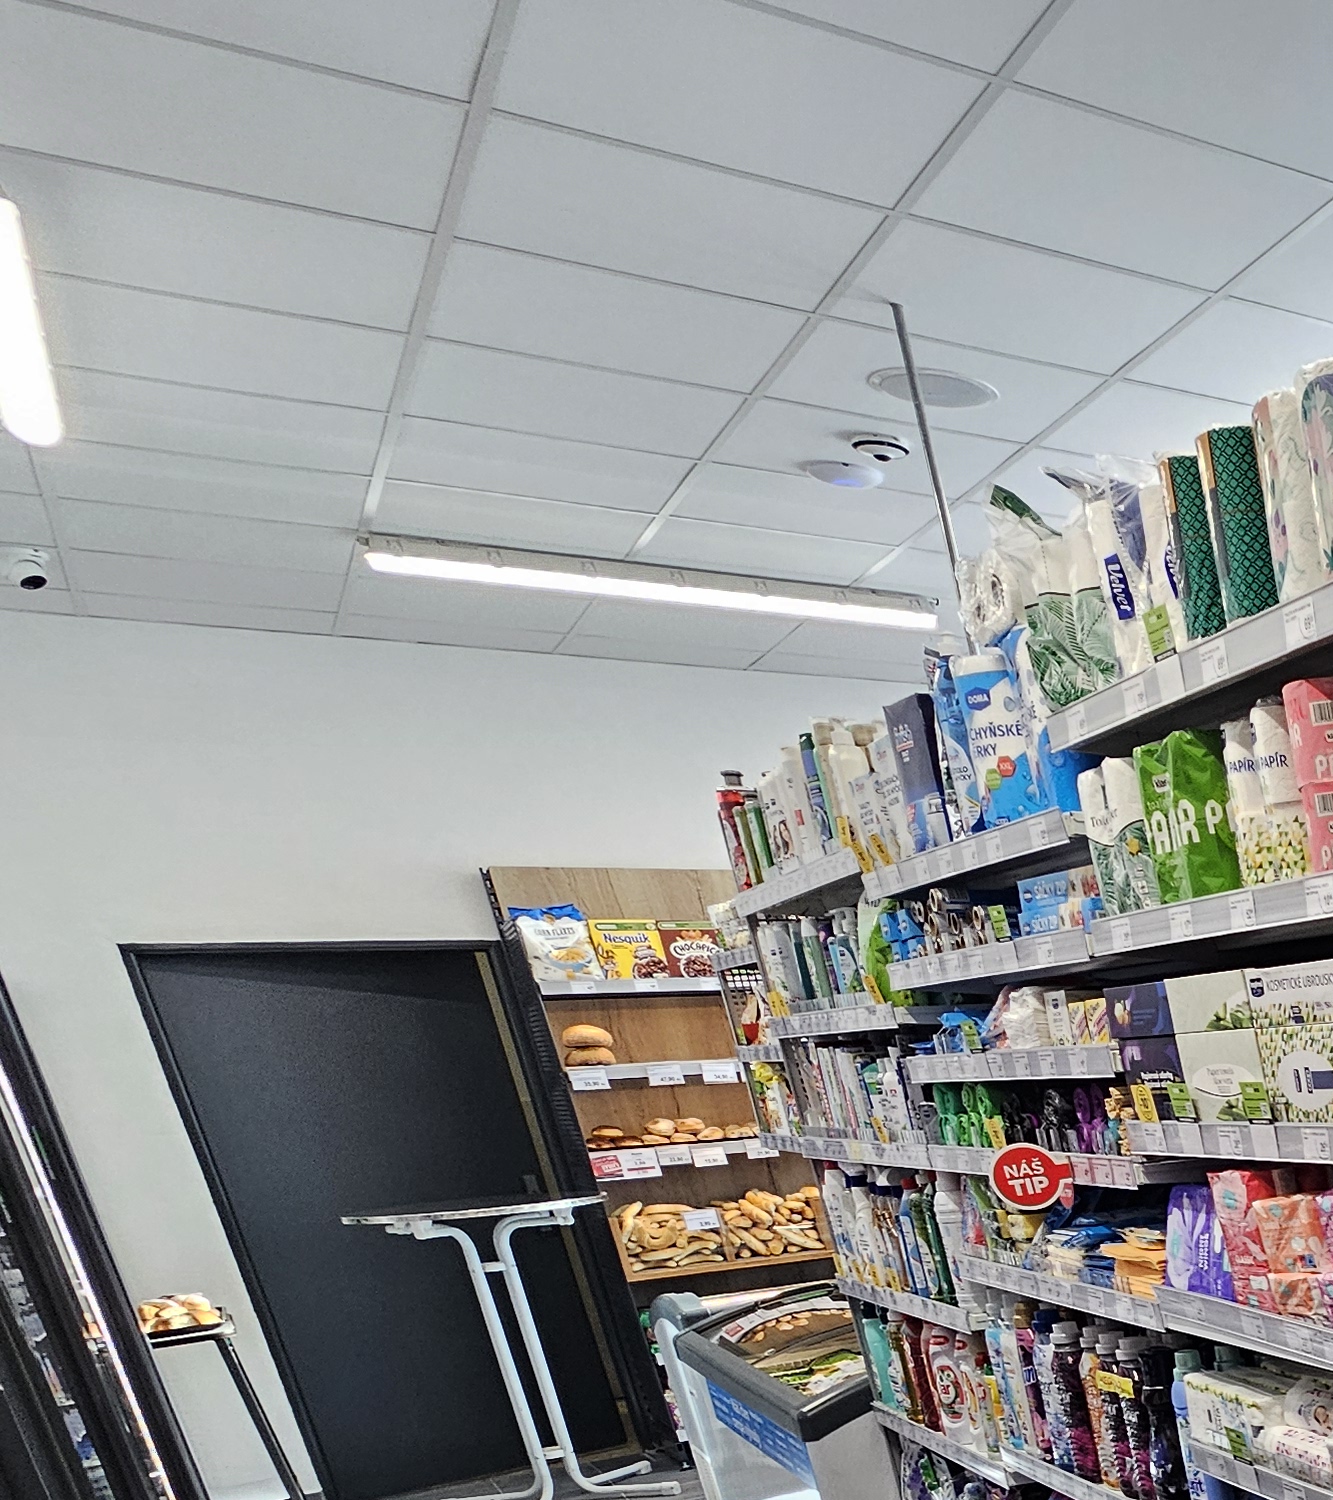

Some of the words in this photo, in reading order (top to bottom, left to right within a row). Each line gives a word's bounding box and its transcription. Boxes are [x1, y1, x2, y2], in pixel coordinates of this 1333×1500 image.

[1105, 559, 1131, 614] Velvet
[1228, 753, 1257, 774] PAPÍR
[1259, 750, 1289, 770] PAPÍR
[602, 932, 651, 945] Nesquik
[1003, 1156, 1045, 1180] NÁŠ
[1007, 1175, 1050, 1197] TIP
